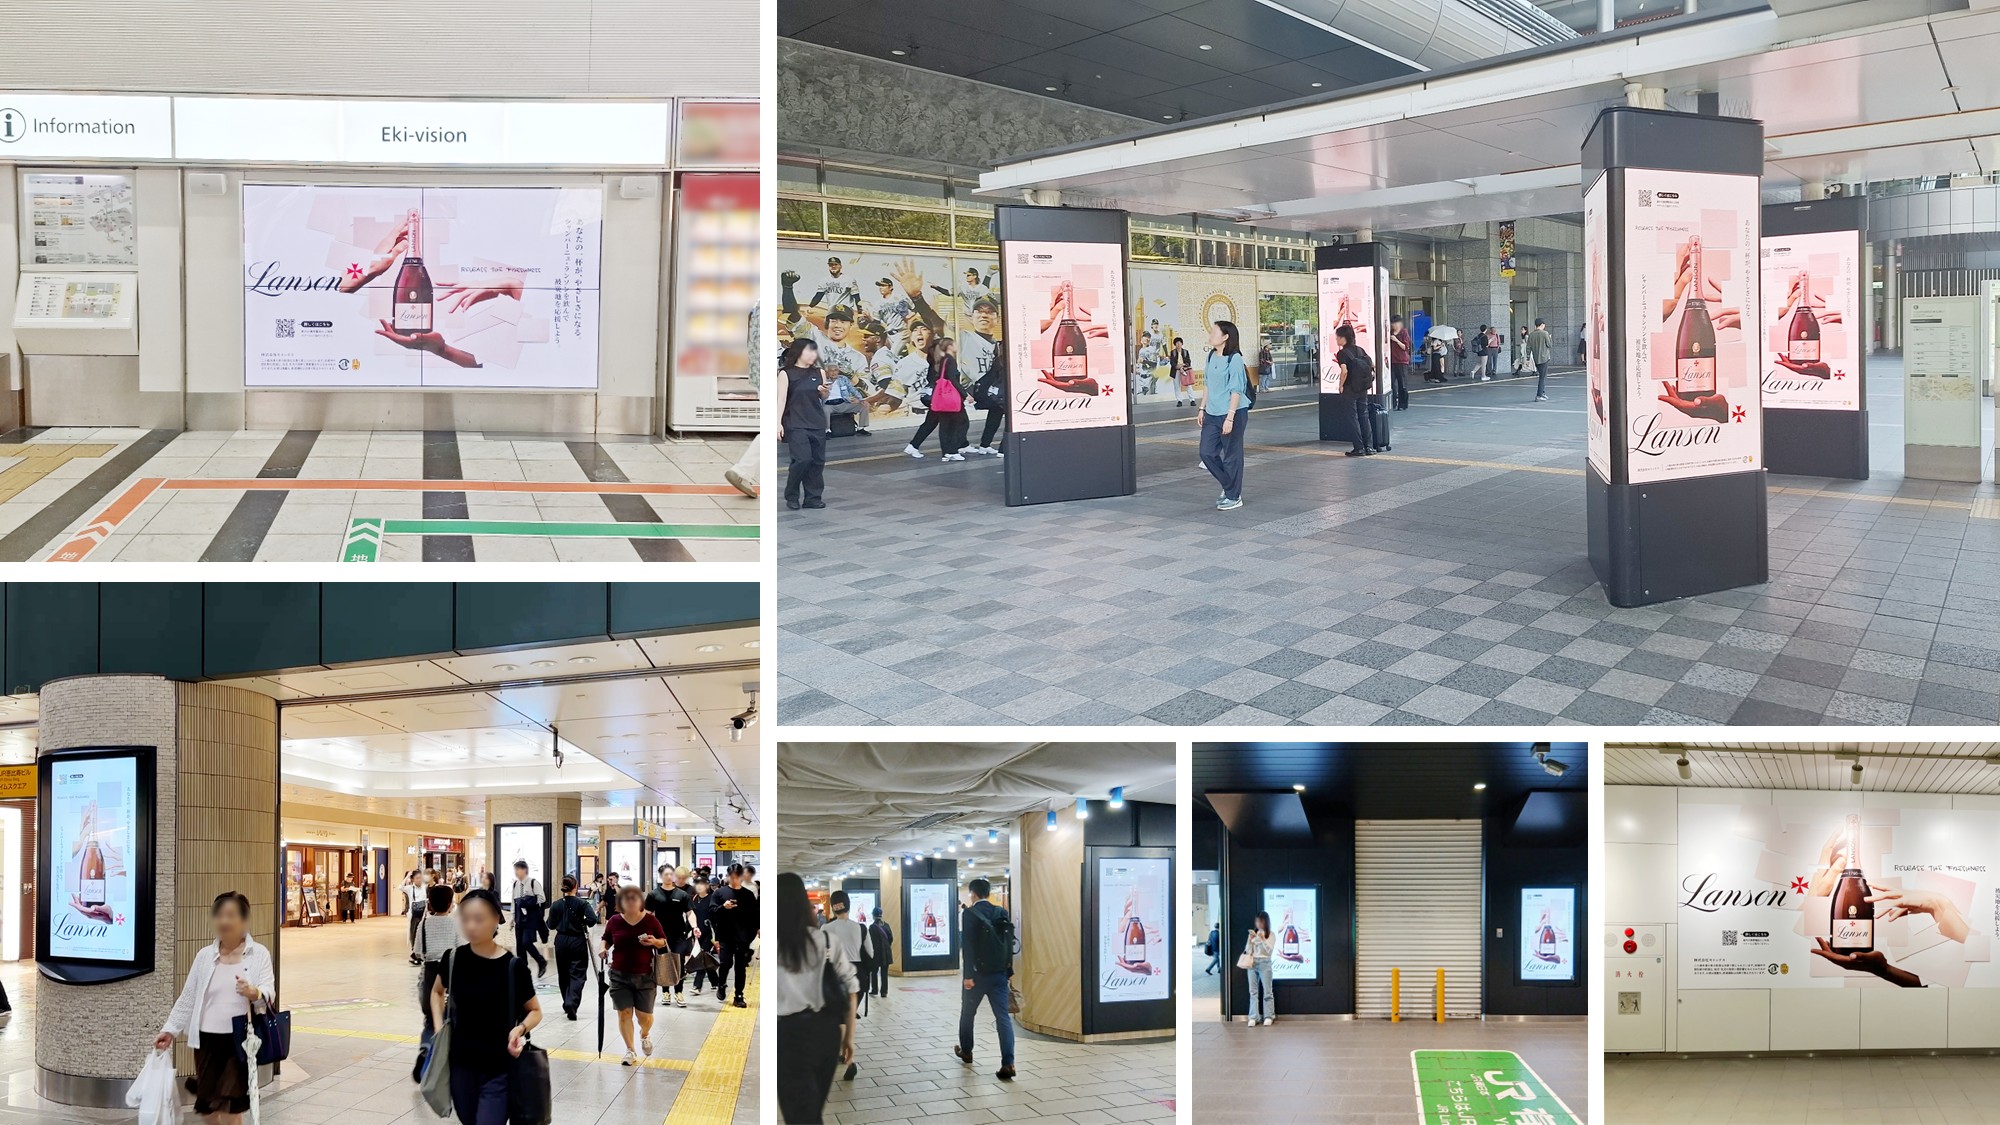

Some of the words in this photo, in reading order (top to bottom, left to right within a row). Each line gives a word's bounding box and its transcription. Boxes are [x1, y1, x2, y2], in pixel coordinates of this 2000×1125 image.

[33, 117, 136, 136] Information
[381, 125, 468, 144] Eki-vision
[248, 260, 344, 297] Lanson
[1681, 365, 1712, 382] Lanson
[1761, 370, 1824, 395] Lanson
[1012, 388, 1093, 416] Lanson
[1628, 412, 1721, 456] Lanson
[1894, 864, 1925, 872] RELEASE
[1928, 864, 1943, 872] THE
[1679, 873, 1787, 913] Lanson
[52, 912, 108, 941] Lanson
[1837, 925, 1870, 940] Lanson
[1523, 959, 1558, 973] Lanson
[1101, 969, 1148, 991] Lanson
[1483, 1070, 1537, 1101] JR
